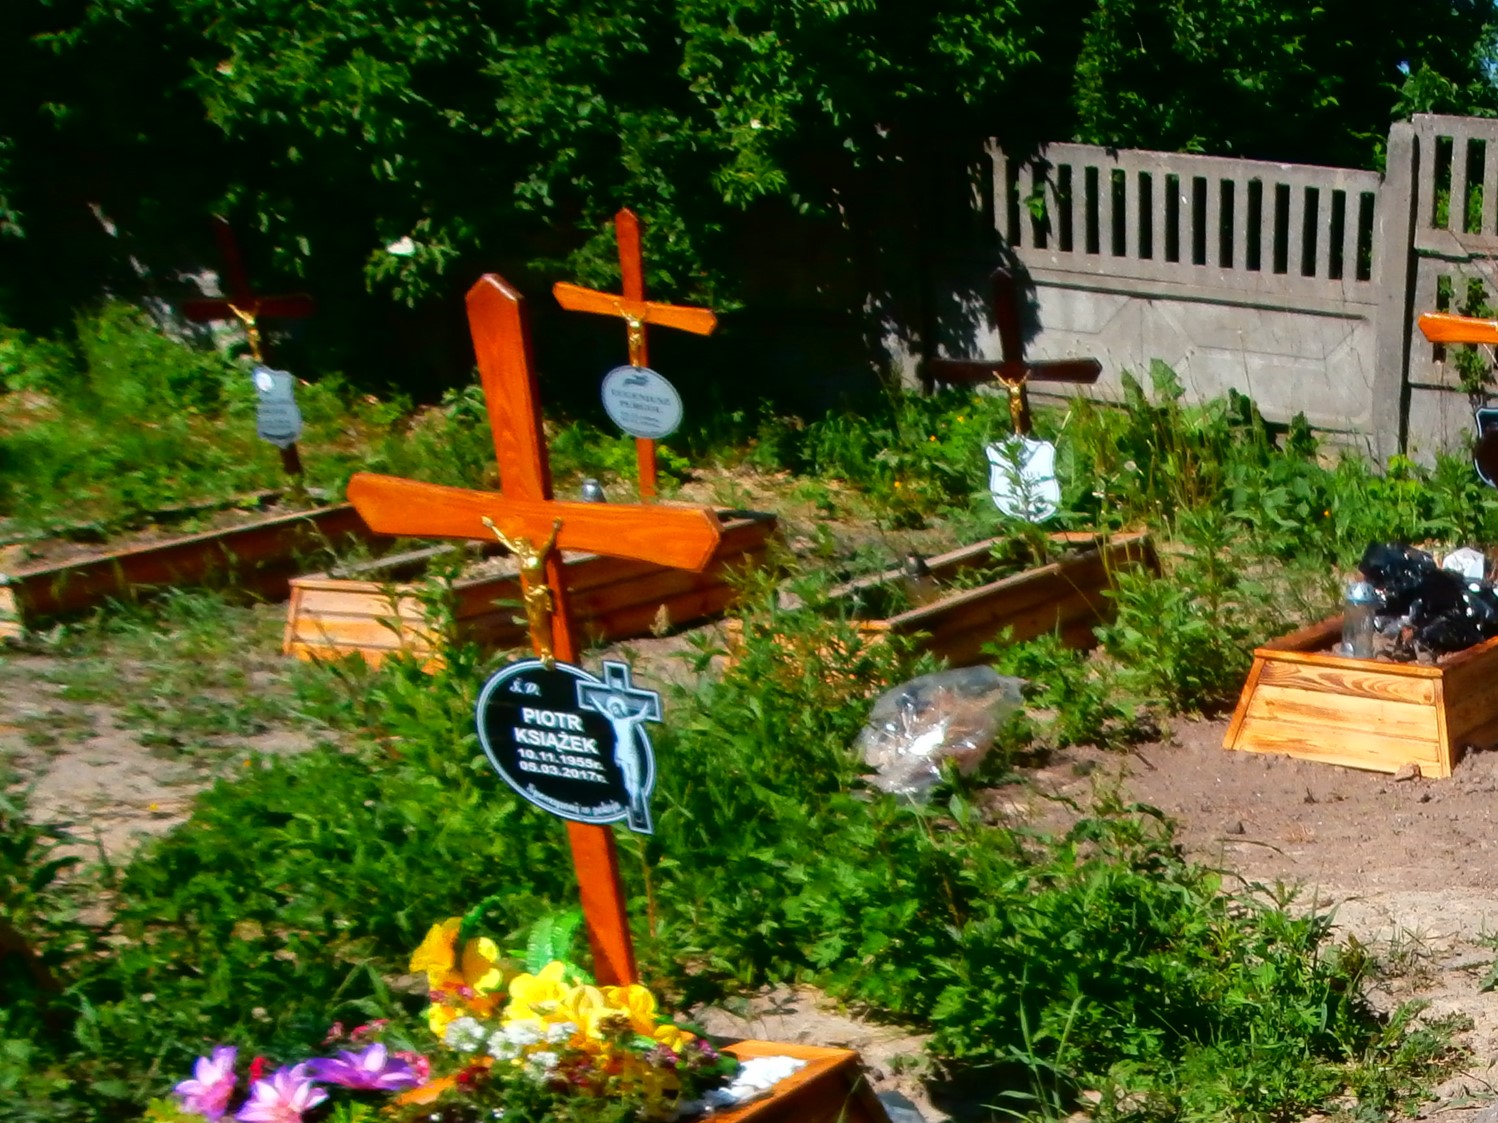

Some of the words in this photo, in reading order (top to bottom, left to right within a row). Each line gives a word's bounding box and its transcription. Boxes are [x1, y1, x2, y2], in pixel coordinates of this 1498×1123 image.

[522, 707, 585, 732] PIOTR
[514, 727, 600, 755] KSIĄŻEK
[517, 748, 607, 772] 10.11.1955r.
[519, 761, 610, 784] 05.03.2017r.
